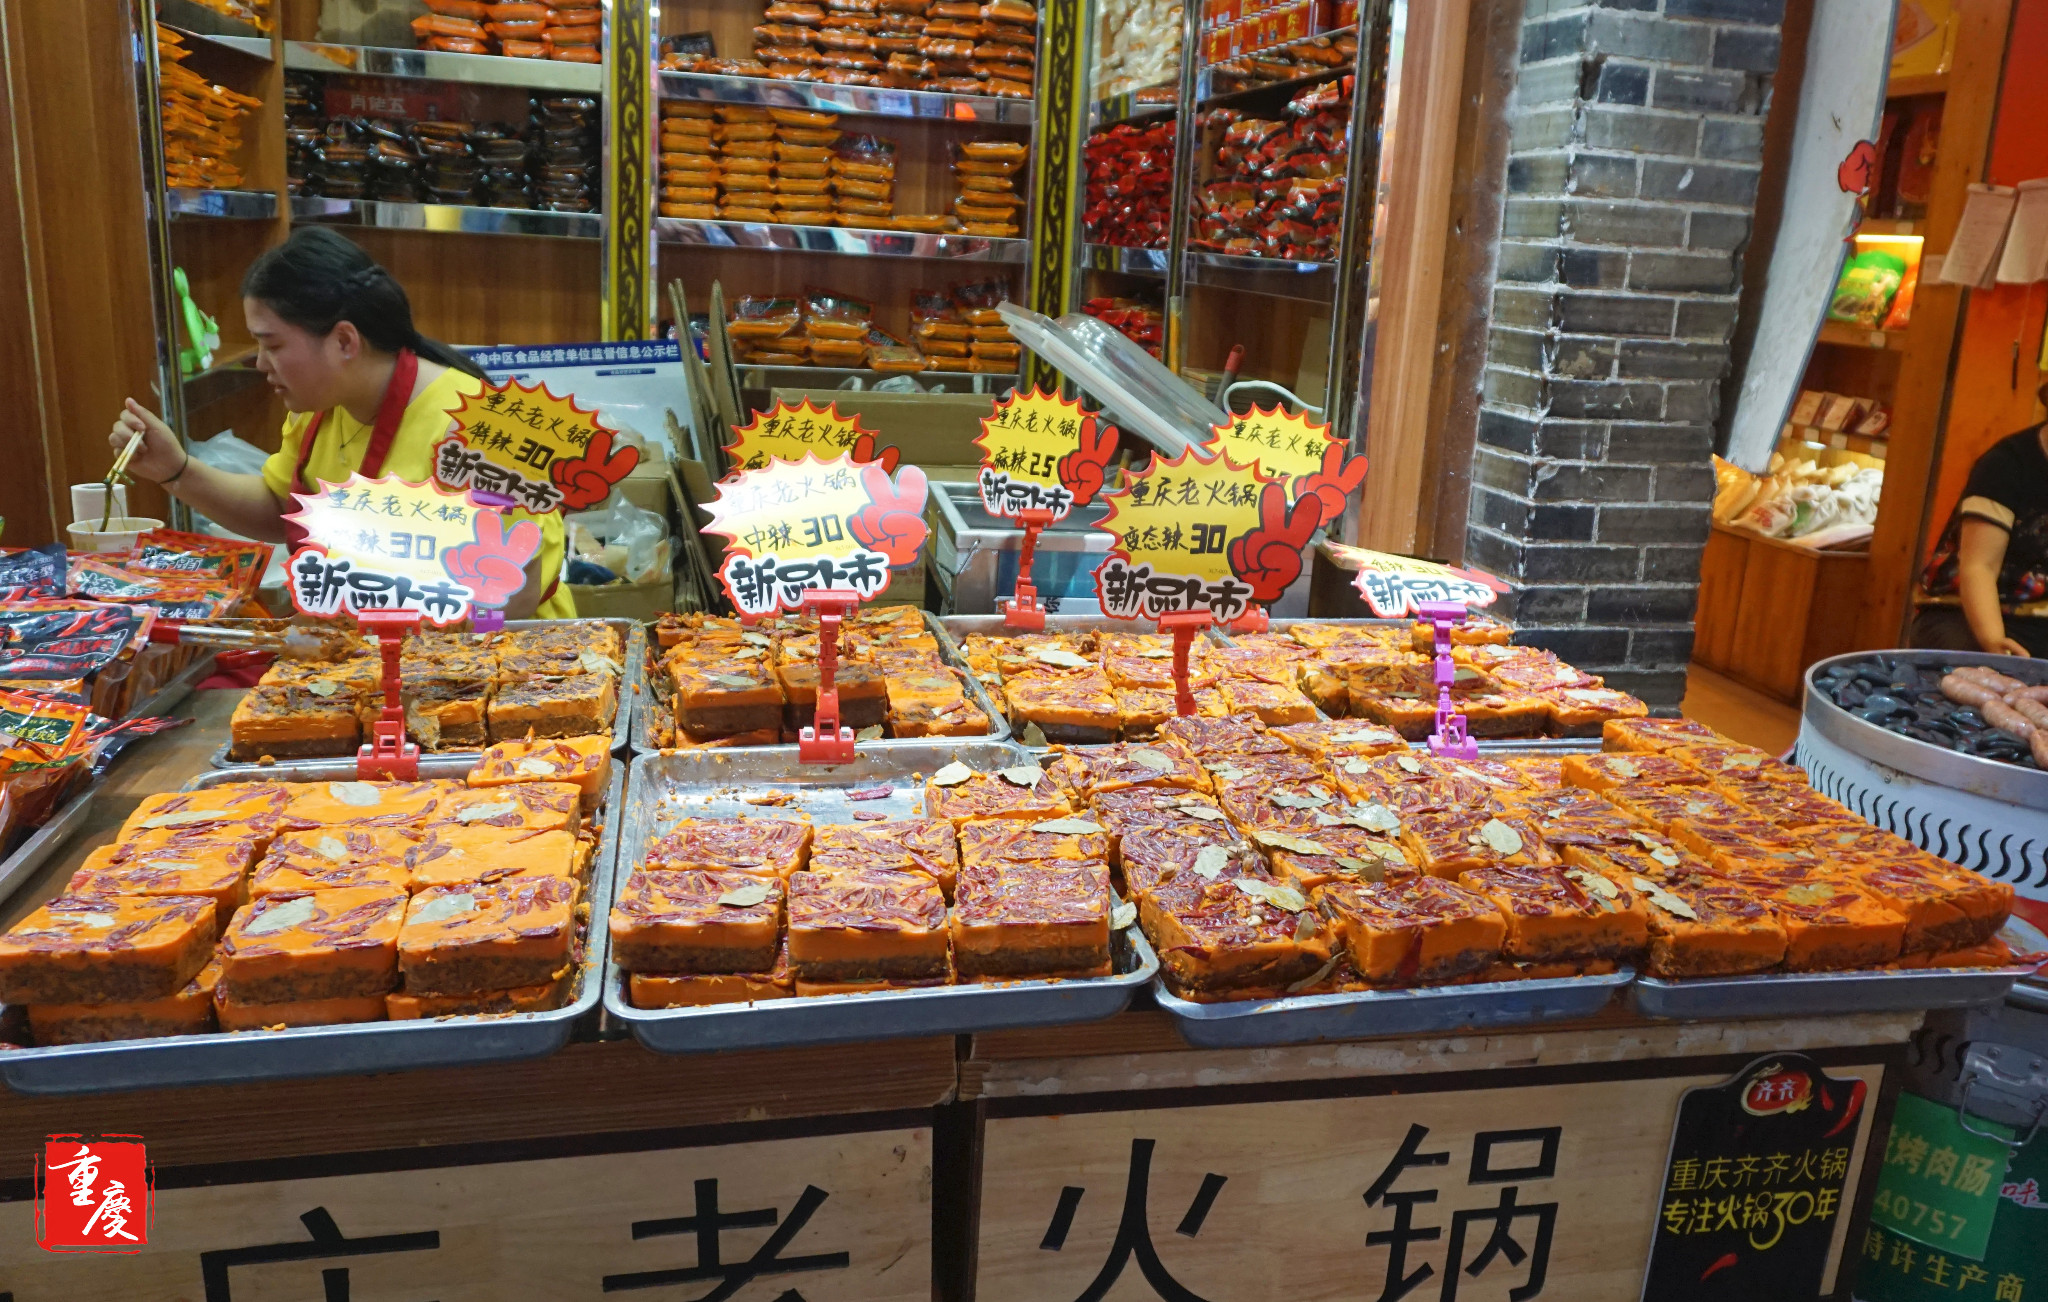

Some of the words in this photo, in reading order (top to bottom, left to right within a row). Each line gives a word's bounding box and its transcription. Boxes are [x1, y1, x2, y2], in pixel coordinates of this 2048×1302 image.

[470, 344, 679, 366] 渝中区食品经营单位监督信息公示栏
[480, 392, 590, 450] 重庆老火锅
[759, 409, 856, 446] 重庆老火锅
[994, 404, 1076, 438] 重庆老火锅
[1229, 420, 1323, 459] 重庆老火锅
[468, 421, 554, 470] 特辣30
[992, 446, 1053, 478] 麻辣25
[440, 443, 564, 507] 新品上市
[1129, 477, 1257, 508] 重庆老火锅
[328, 487, 468, 526] 重庆老火锅
[984, 477, 1071, 513] 新品上市
[327, 530, 436, 560] 辣30
[743, 515, 843, 553] 中辣30
[1123, 523, 1228, 554] 变态辣30
[296, 553, 470, 618] 新品上市
[730, 554, 885, 610] 新品上市
[1104, 563, 1251, 619] 新品上市
[1365, 573, 1490, 611] 新品上市
[1755, 1078, 1795, 1102] 齐齐
[1668, 1147, 1849, 1192] 重庆齐齐火锅
[1039, 1123, 1562, 1302] 火锅
[1662, 1186, 1840, 1250] 专注火锅30年
